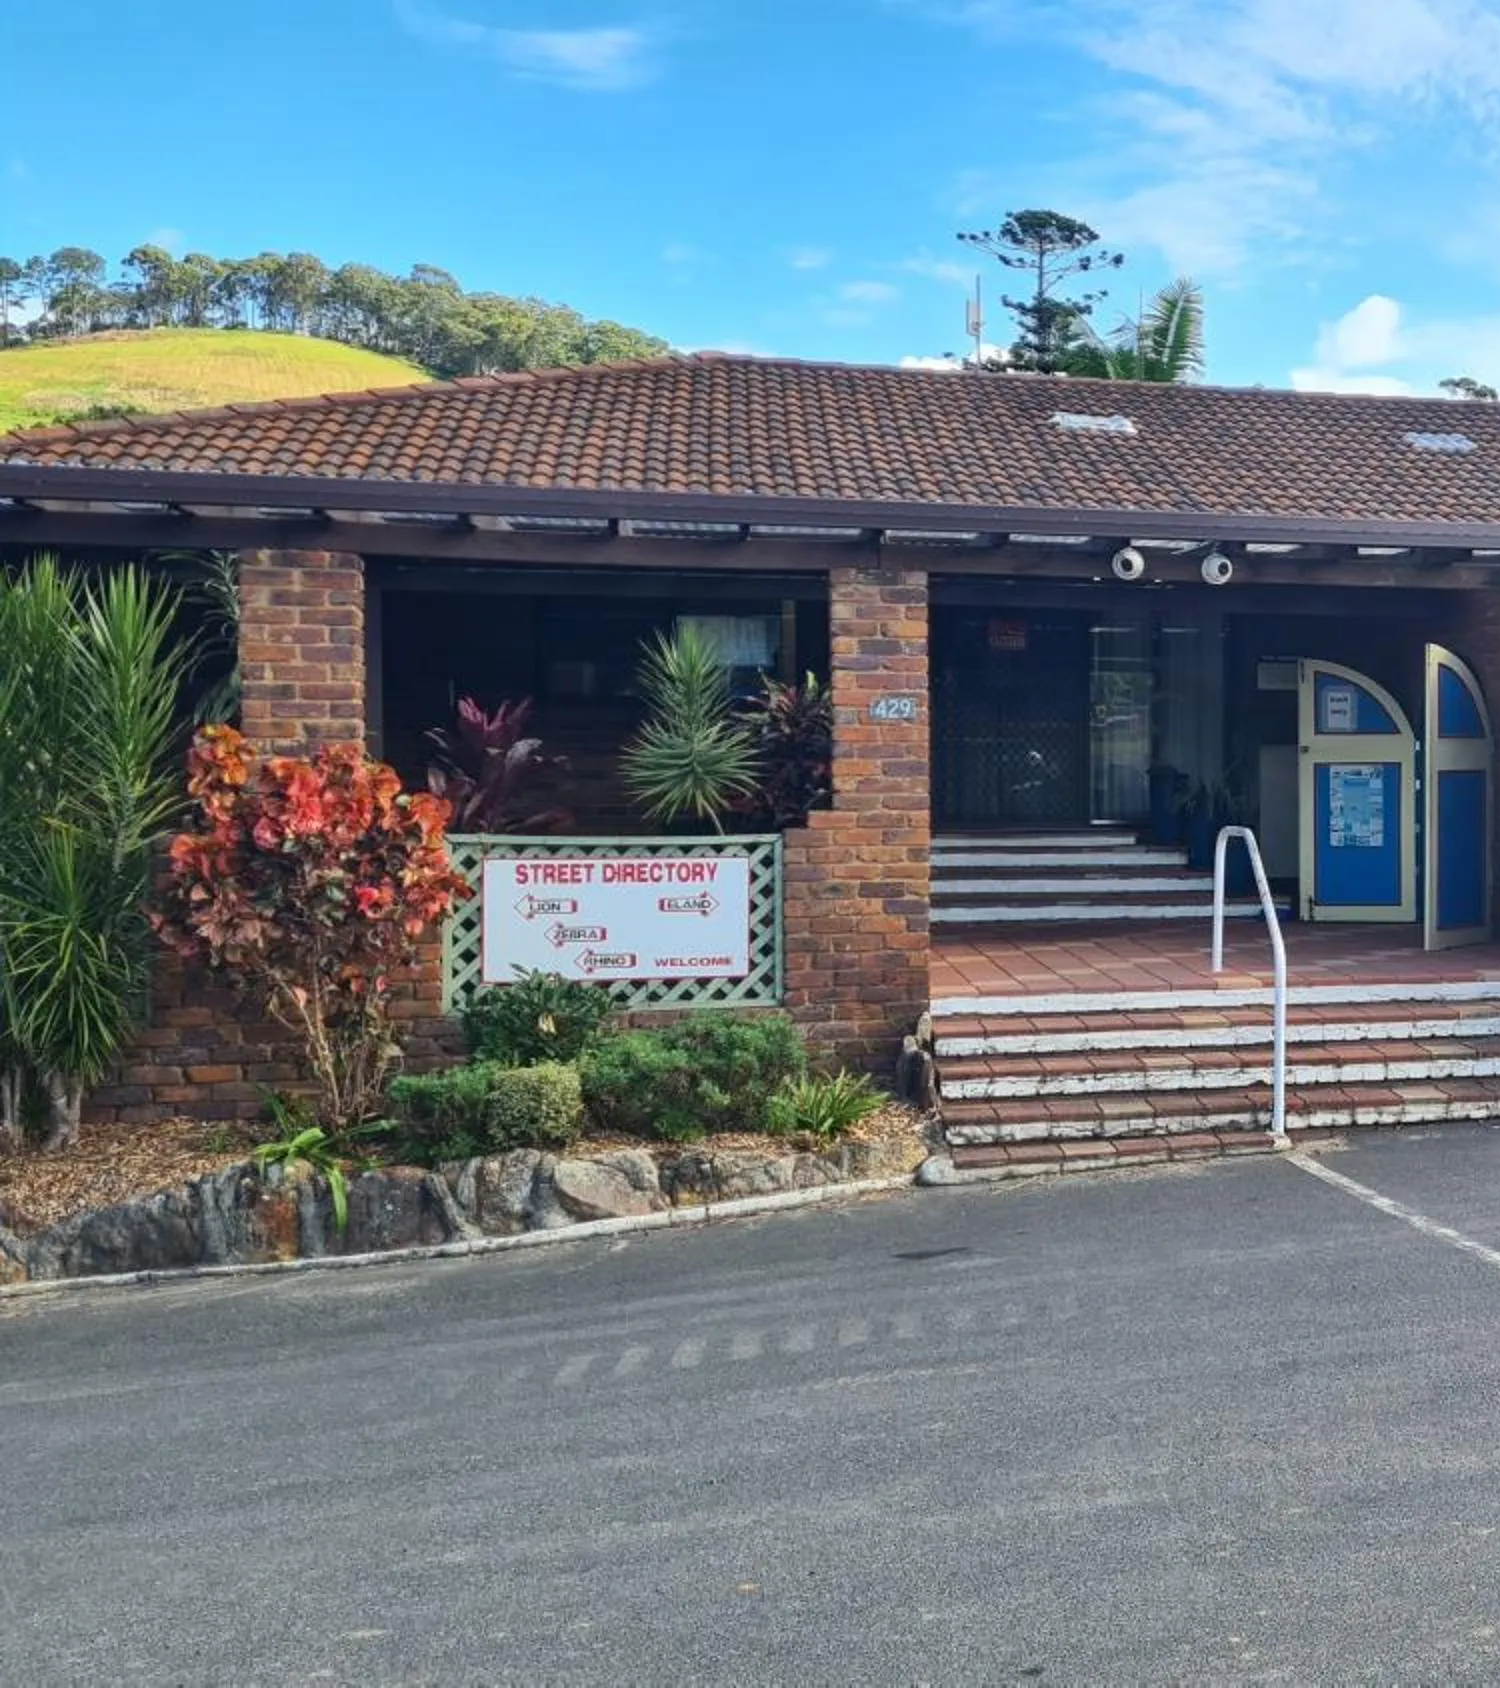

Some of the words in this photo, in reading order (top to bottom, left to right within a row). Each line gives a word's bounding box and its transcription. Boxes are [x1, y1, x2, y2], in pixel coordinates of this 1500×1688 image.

[875, 699, 911, 719] 429
[515, 863, 594, 884] STREET
[602, 862, 718, 884] DIRECTORY
[655, 957, 734, 967] WELCOME
